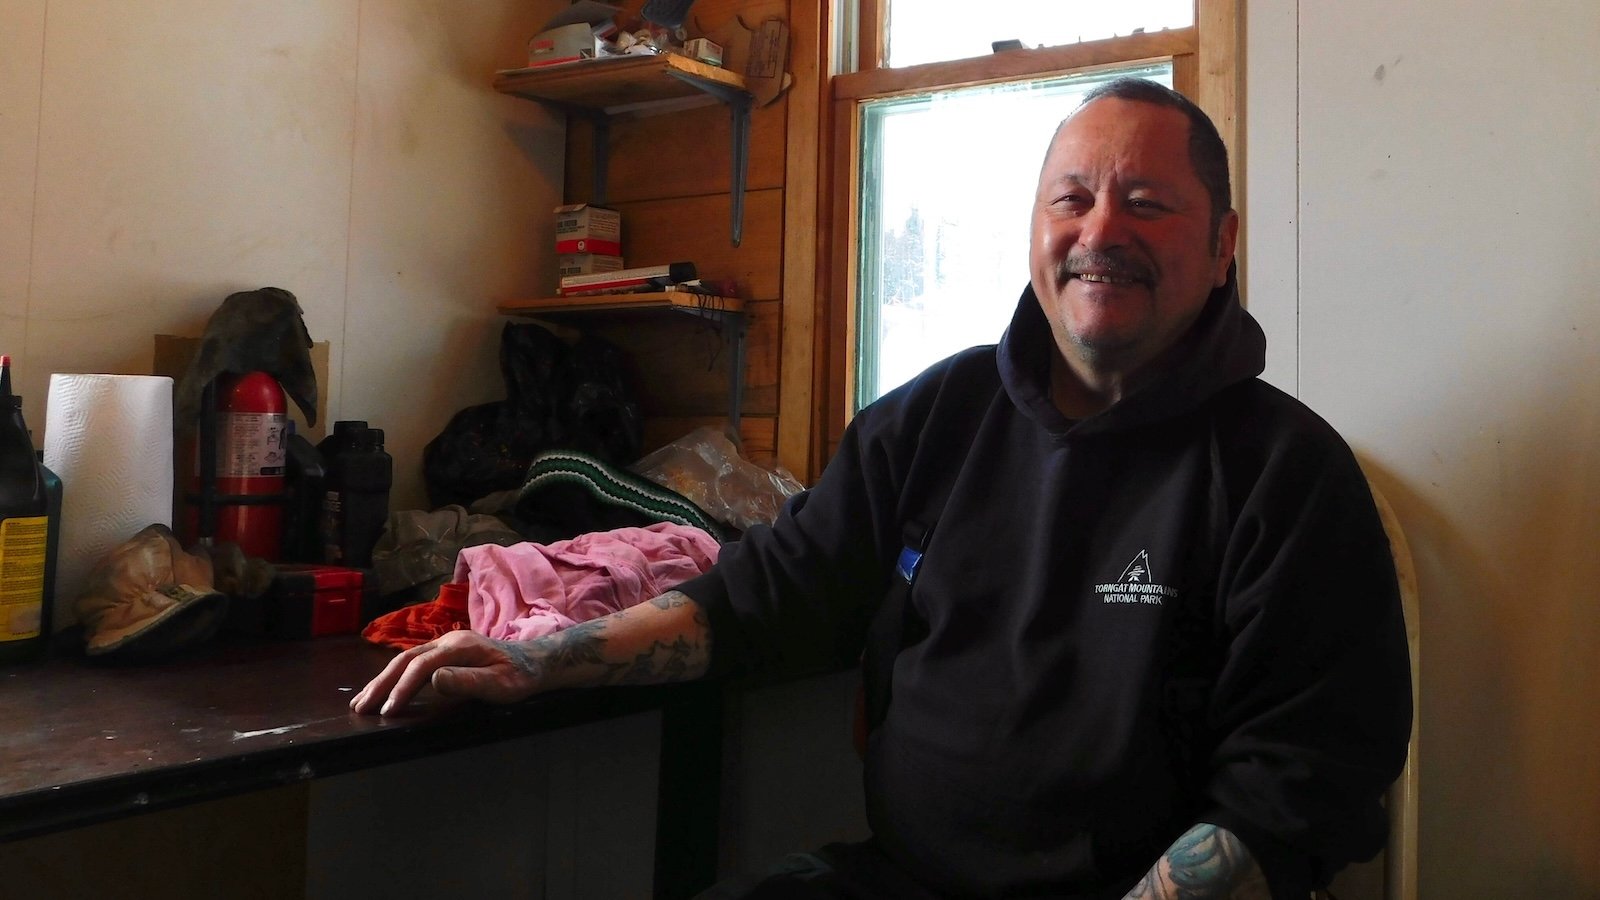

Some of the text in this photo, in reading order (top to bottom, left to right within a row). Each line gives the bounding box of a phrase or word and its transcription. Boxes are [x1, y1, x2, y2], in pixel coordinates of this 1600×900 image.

[1095, 583, 1178, 597] TORNGAT MOUNTAINS
[1104, 594, 1163, 605] NATIONAL PARK
